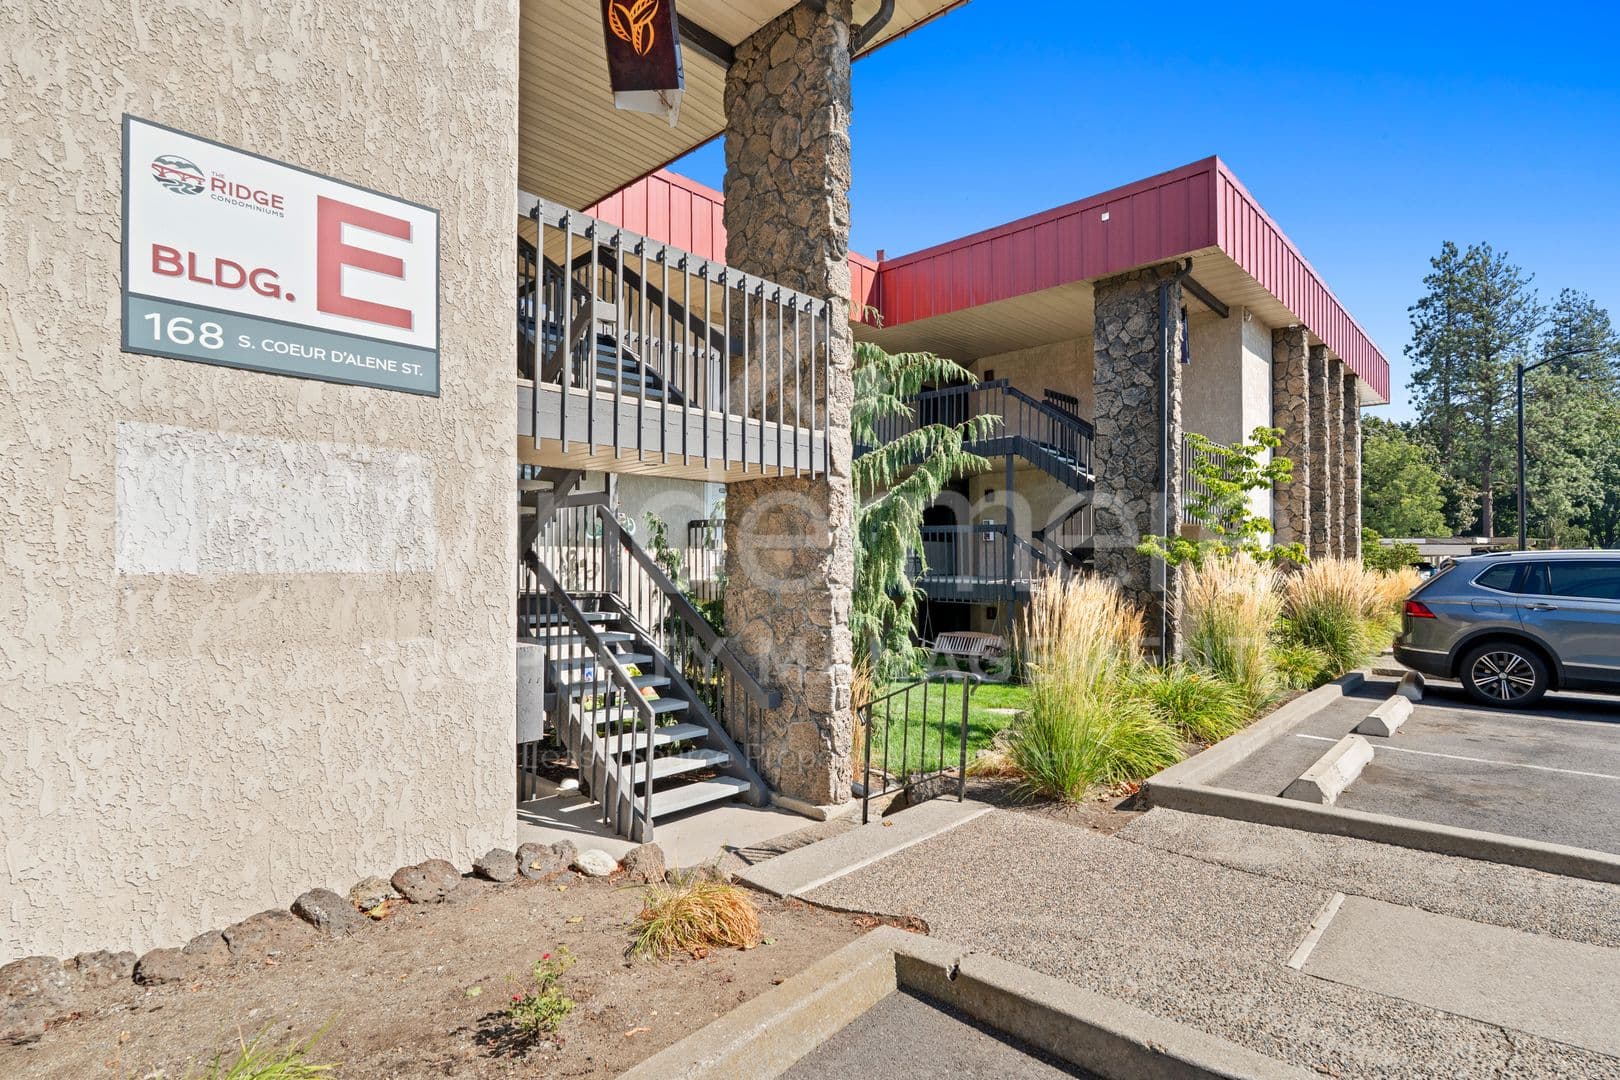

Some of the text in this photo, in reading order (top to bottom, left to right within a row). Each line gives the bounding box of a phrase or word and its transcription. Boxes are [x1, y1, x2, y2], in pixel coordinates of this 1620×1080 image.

[211, 171, 225, 179] THE
[211, 177, 284, 210] RIDGE
[210, 194, 285, 218] CONDOMINIUMS
[152, 244, 296, 302] BLDG.
[317, 195, 413, 329] E
[144, 312, 423, 377] 168 S. COEUR D'ALENE ST.
